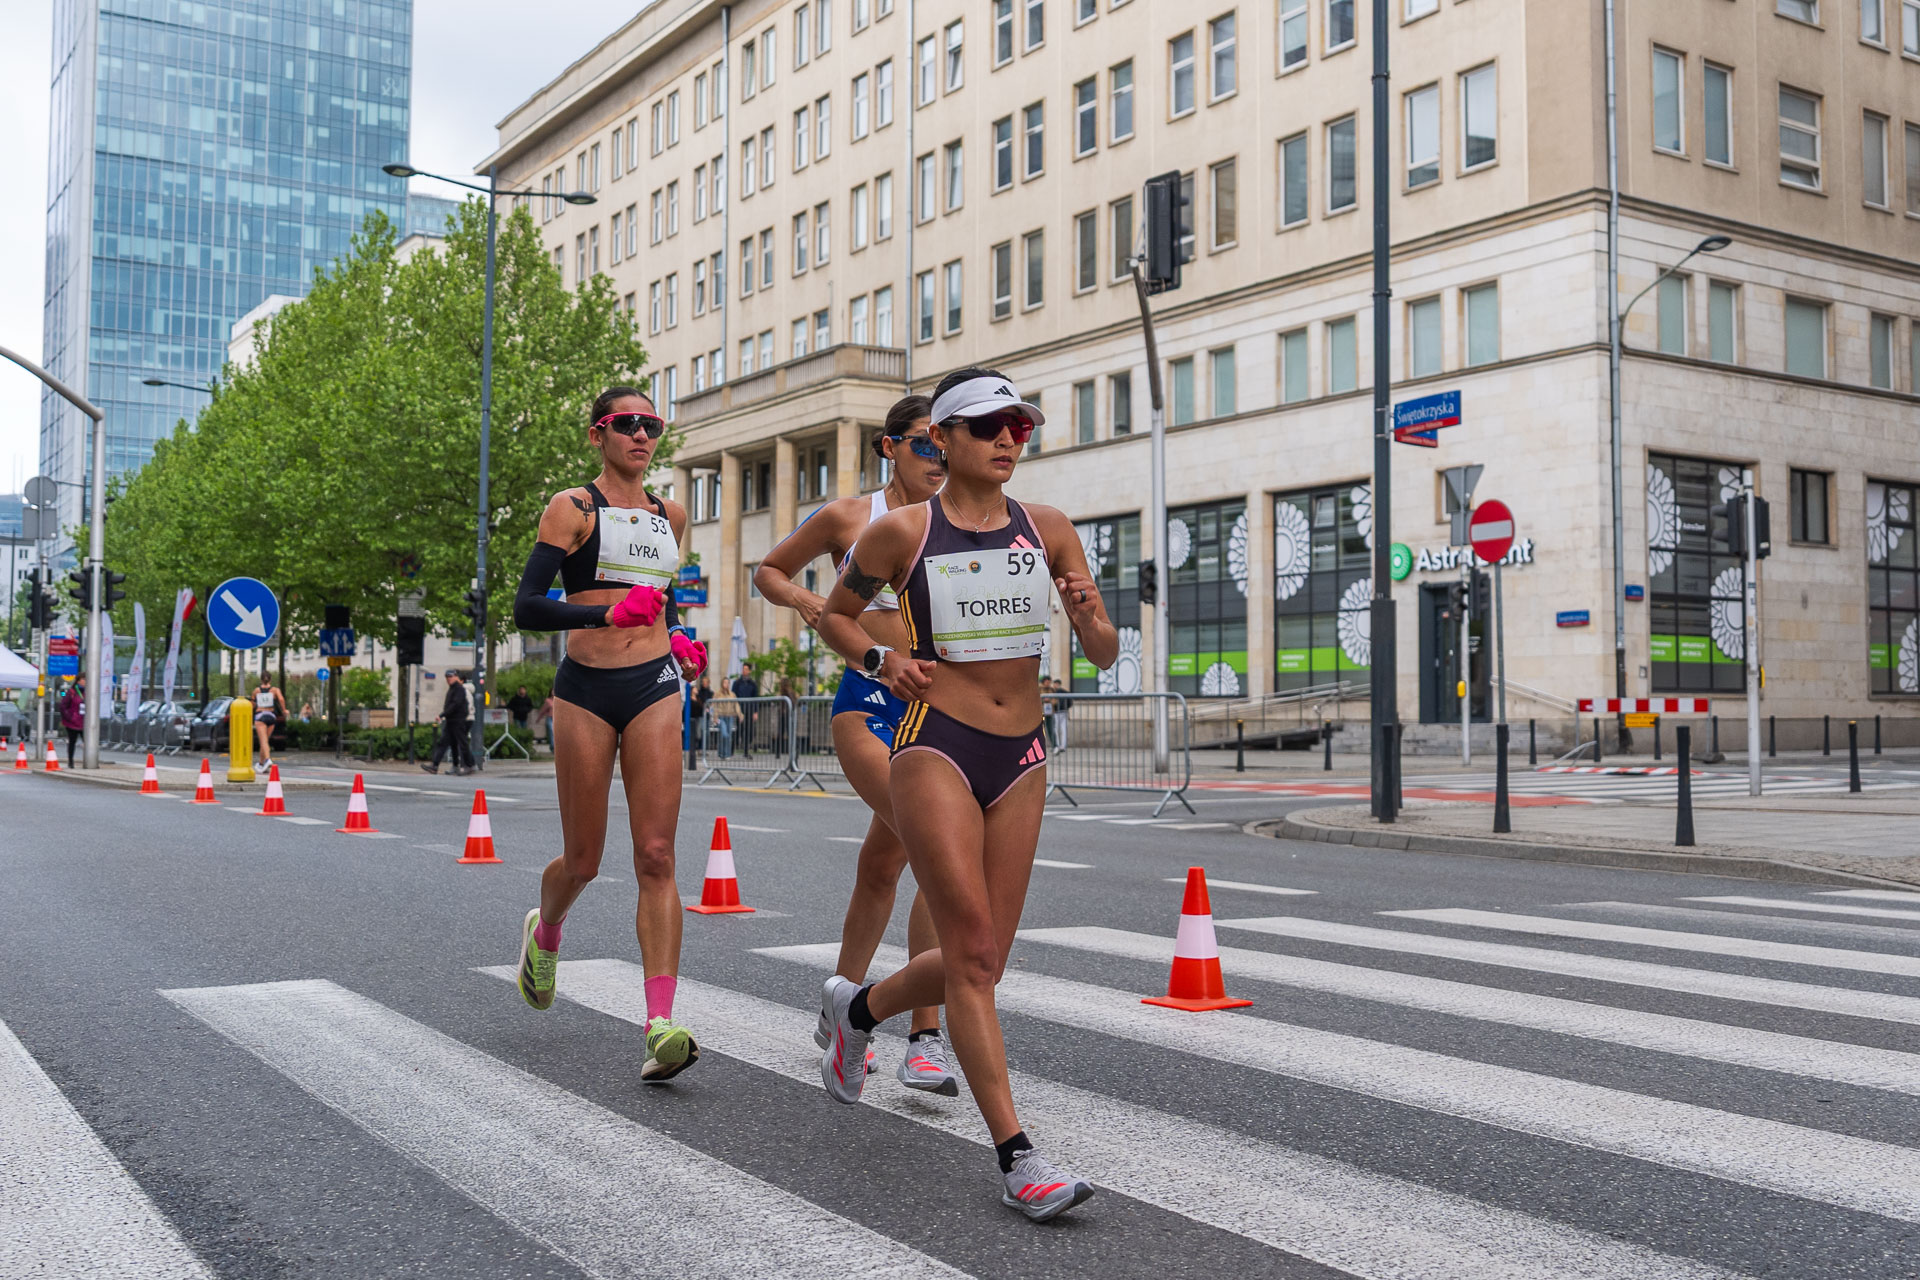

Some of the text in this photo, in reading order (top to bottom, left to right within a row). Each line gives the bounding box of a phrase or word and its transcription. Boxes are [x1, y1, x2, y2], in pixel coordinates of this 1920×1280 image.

[1397, 400, 1455, 425] Świętokrzyska
[650, 516, 667, 535] 53
[629, 543, 660, 560] LYRA
[1007, 552, 1036, 576] 59
[957, 597, 1031, 618] TORRES
[656, 673, 678, 684] adidas
